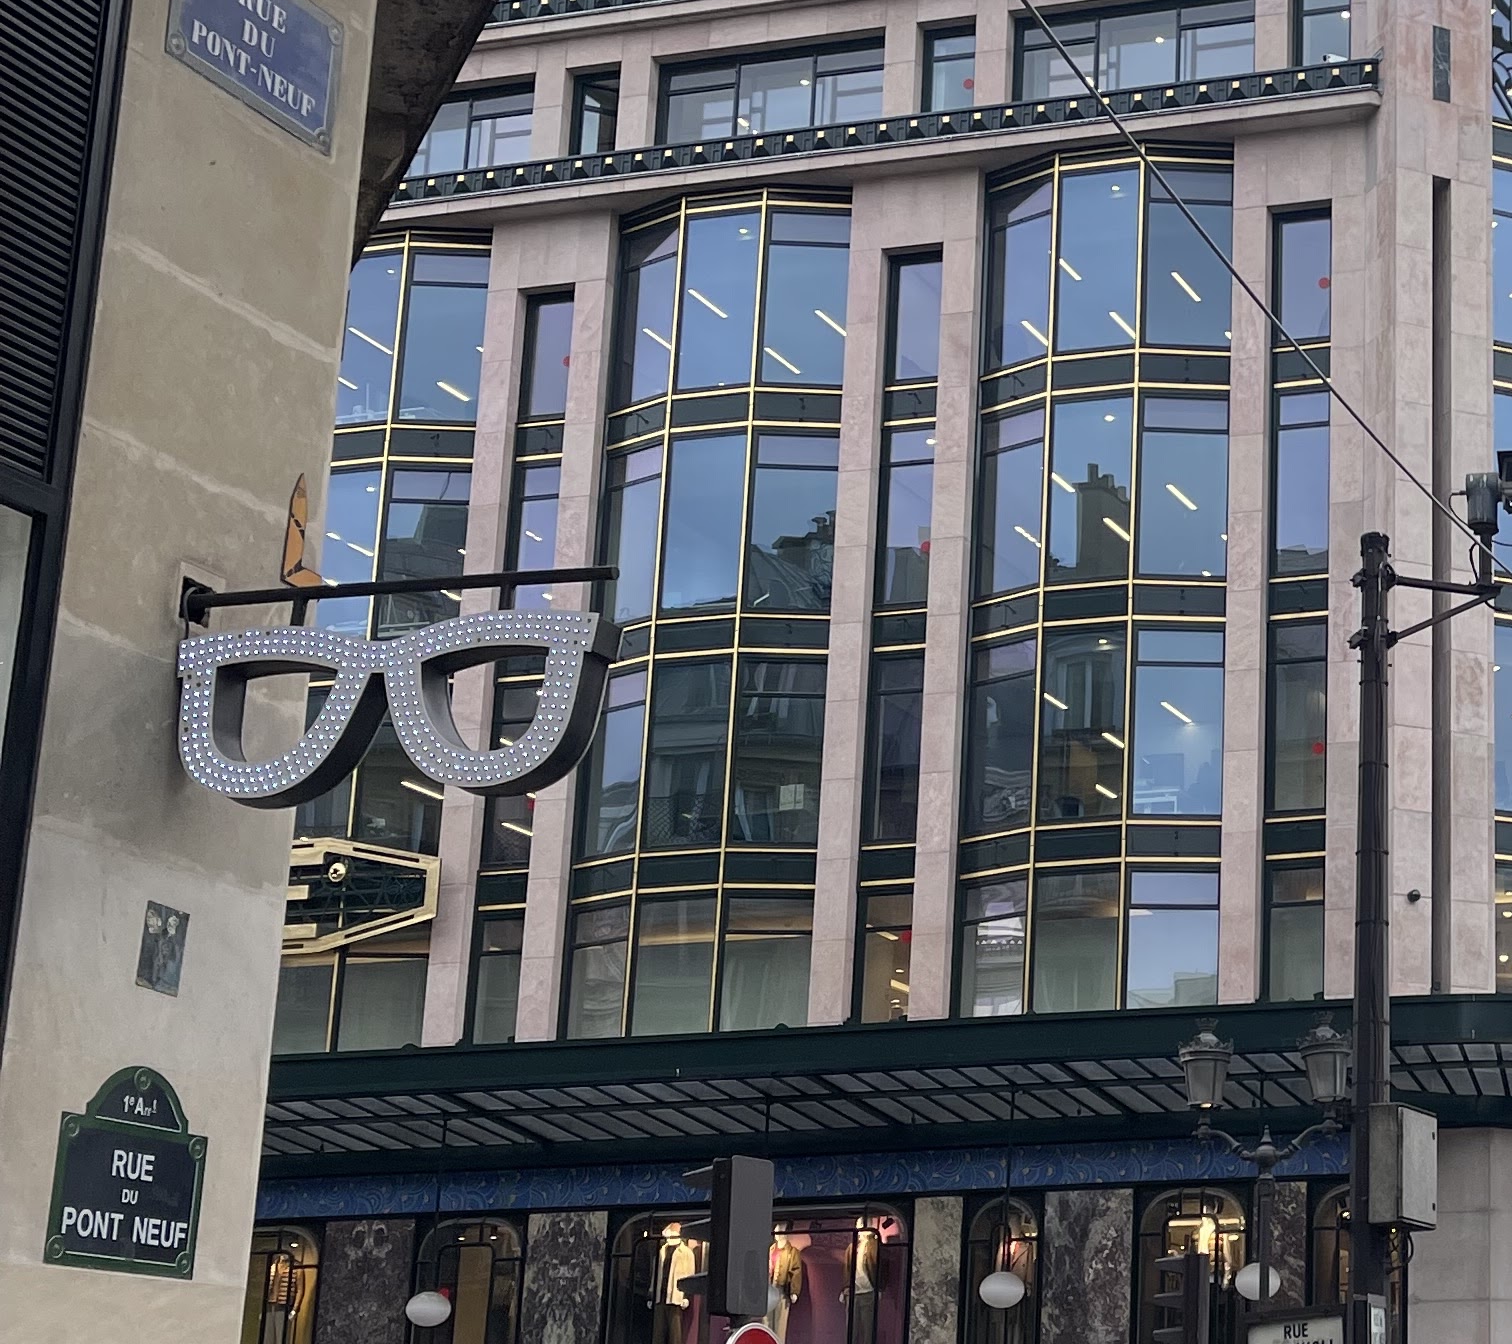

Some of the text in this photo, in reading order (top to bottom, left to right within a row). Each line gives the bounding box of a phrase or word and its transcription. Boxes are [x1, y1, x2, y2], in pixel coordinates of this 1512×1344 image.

[242, 18, 276, 58] DU
[191, 18, 316, 117] PONT-NEUF
[111, 1149, 156, 1182] RUE
[121, 1188, 139, 1205] DU
[61, 1206, 189, 1249] PONT NEUF
[1284, 1323, 1309, 1339] RUE
